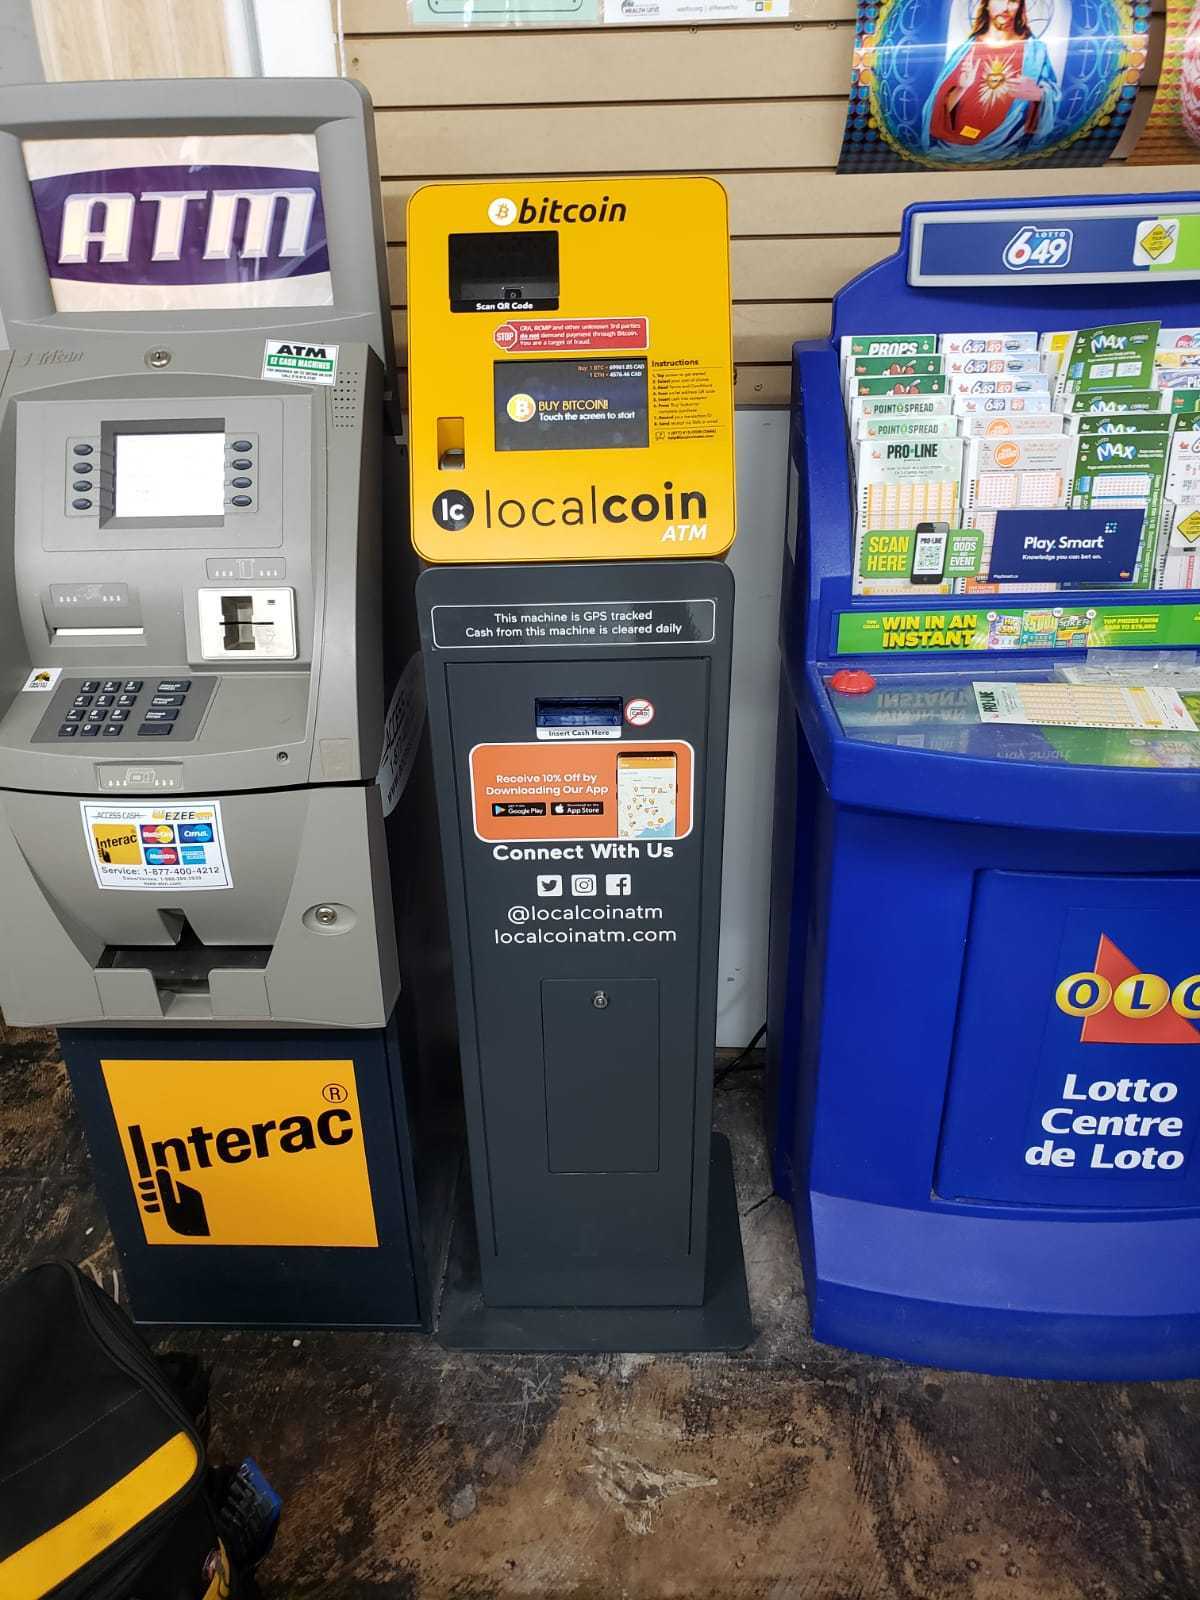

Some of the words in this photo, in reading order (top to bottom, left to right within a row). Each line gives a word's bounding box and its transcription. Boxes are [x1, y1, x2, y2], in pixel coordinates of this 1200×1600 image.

[518, 196, 627, 224] bitcoin
[59, 187, 316, 264] ATM
[475, 303, 496, 311] Scan
[497, 302, 511, 310] QR
[511, 302, 534, 310] Code
[496, 332, 514, 341] STOP
[1090, 334, 1127, 354] MAX
[277, 345, 327, 358] ATM
[651, 359, 699, 367] Instructions
[538, 400, 560, 411] BUY
[874, 404, 897, 414] POINT
[904, 402, 934, 413] SPREAD
[540, 412, 563, 421] Touch
[564, 412, 577, 420] the
[579, 412, 606, 420] screen
[606, 412, 616, 420] to
[617, 411, 635, 419] start
[878, 425, 900, 434] POINT
[908, 424, 938, 434] SPREAD
[1096, 442, 1136, 461] MAX
[486, 481, 708, 529] localcoin
[661, 524, 708, 543] ATM
[868, 536, 910, 553] SCAN
[1058, 535, 1105, 549] Smart
[866, 555, 906, 571] HERE
[950, 556, 976, 567] EVENT
[1022, 554, 1056, 562] Knowledge
[494, 613, 518, 623] This
[520, 612, 568, 623] machine
[571, 611, 581, 622] is
[583, 610, 608, 622] GPS
[611, 609, 653, 621] tracked
[882, 615, 920, 631] WIN
[924, 615, 945, 630] IN
[947, 614, 977, 630] AN
[465, 627, 494, 638] Cash
[496, 627, 523, 637] from
[525, 626, 546, 637] this
[549, 625, 596, 636] machine
[599, 625, 608, 635] is
[611, 623, 653, 634] cleared
[655, 623, 682, 636] daily
[882, 631, 976, 649] INSTANT
[496, 774, 541, 783] Receive
[542, 774, 561, 783] 10%
[564, 773, 582, 782] Off
[583, 773, 597, 783] by
[486, 785, 561, 796] Downloading
[562, 785, 583, 794] Our
[585, 785, 609, 796] App
[96, 834, 138, 850] Interac
[492, 844, 584, 861] Connect
[590, 843, 640, 859] With
[647, 843, 674, 858] Us
[101, 866, 140, 876] Service:
[507, 904, 663, 925] @localcoinatm
[494, 928, 677, 944] localcoinatm.com
[1062, 1073, 1178, 1103] Lotto
[1041, 1107, 1183, 1137] Centre
[127, 1108, 354, 1179] Interac
[1024, 1139, 1076, 1168] de
[1090, 1143, 1185, 1170] Loto
